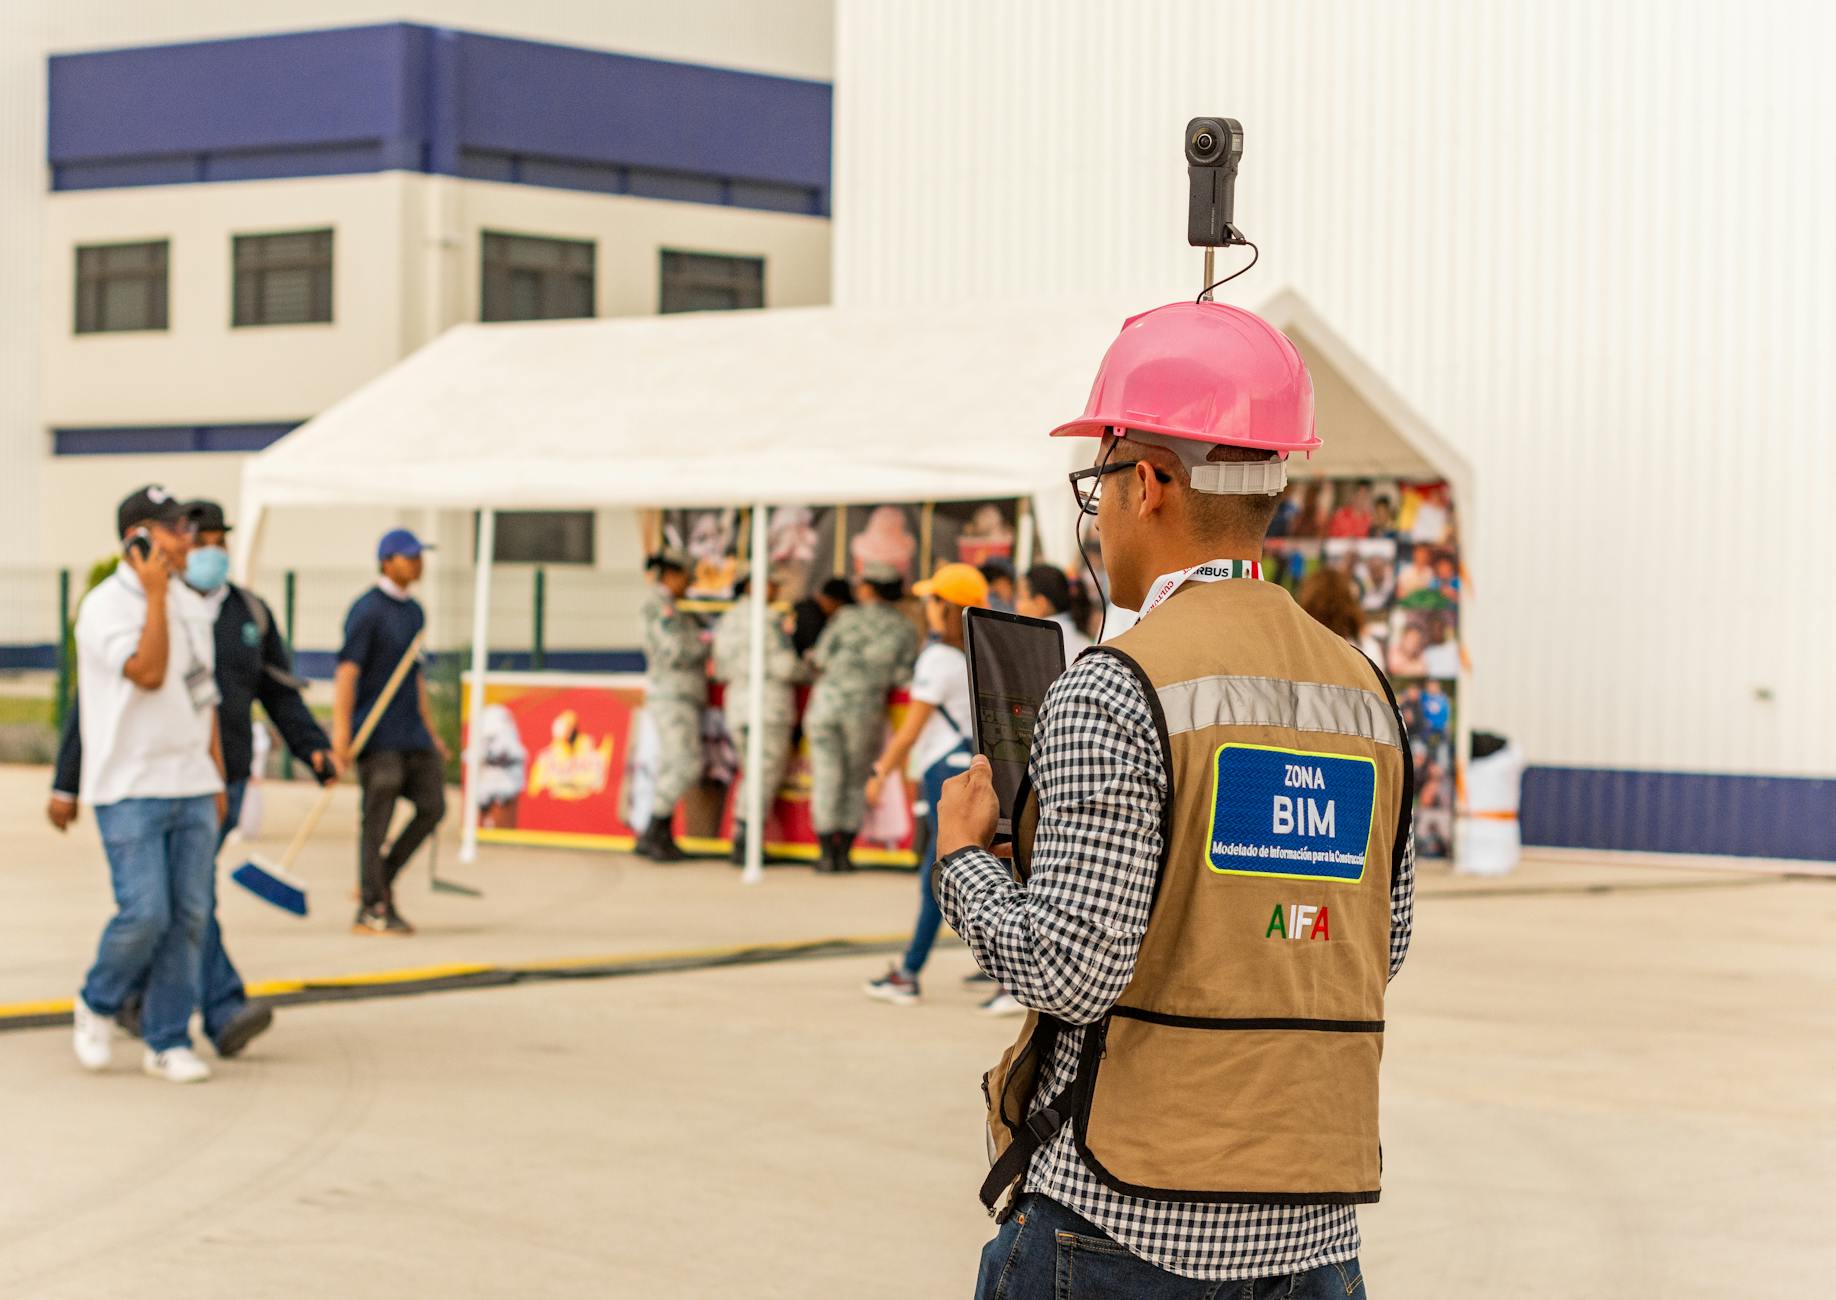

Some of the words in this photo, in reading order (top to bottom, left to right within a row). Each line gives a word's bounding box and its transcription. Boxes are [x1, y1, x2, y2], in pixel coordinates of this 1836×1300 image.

[1193, 566, 1229, 578] RBUS
[1284, 764, 1326, 790] ZONA
[1272, 795, 1336, 839] BIM
[1212, 841, 1258, 857] Modelado
[1259, 845, 1269, 858] de
[1270, 845, 1312, 861] Información
[1312, 851, 1329, 864] para
[1329, 850, 1335, 863] la
[1265, 904, 1330, 941] AIFA
